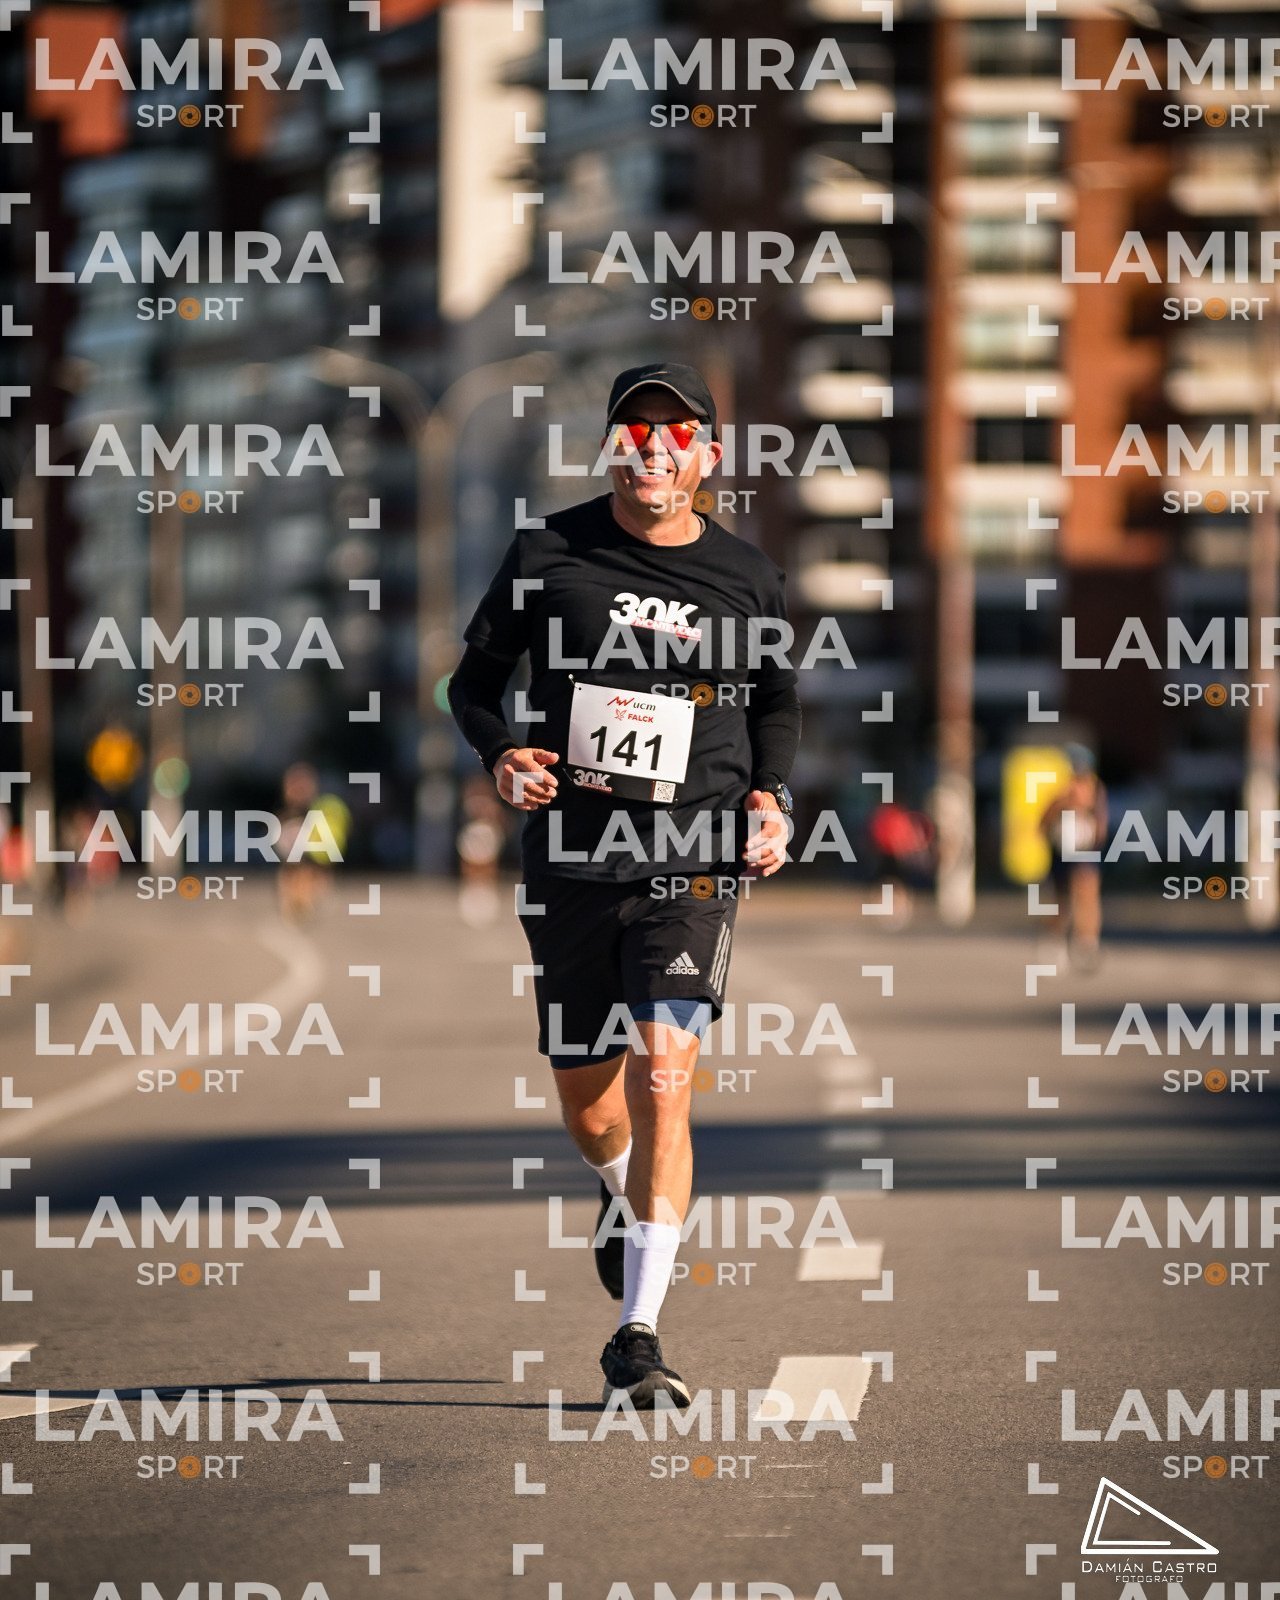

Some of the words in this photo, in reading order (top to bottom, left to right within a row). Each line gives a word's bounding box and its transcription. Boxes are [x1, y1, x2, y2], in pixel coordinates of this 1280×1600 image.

[609, 592, 699, 628] 30K
[633, 702, 657, 712] ucm
[627, 713, 654, 724] FALCK
[589, 725, 663, 771] 141
[573, 769, 611, 787] 30K
[666, 965, 700, 976] adidas
